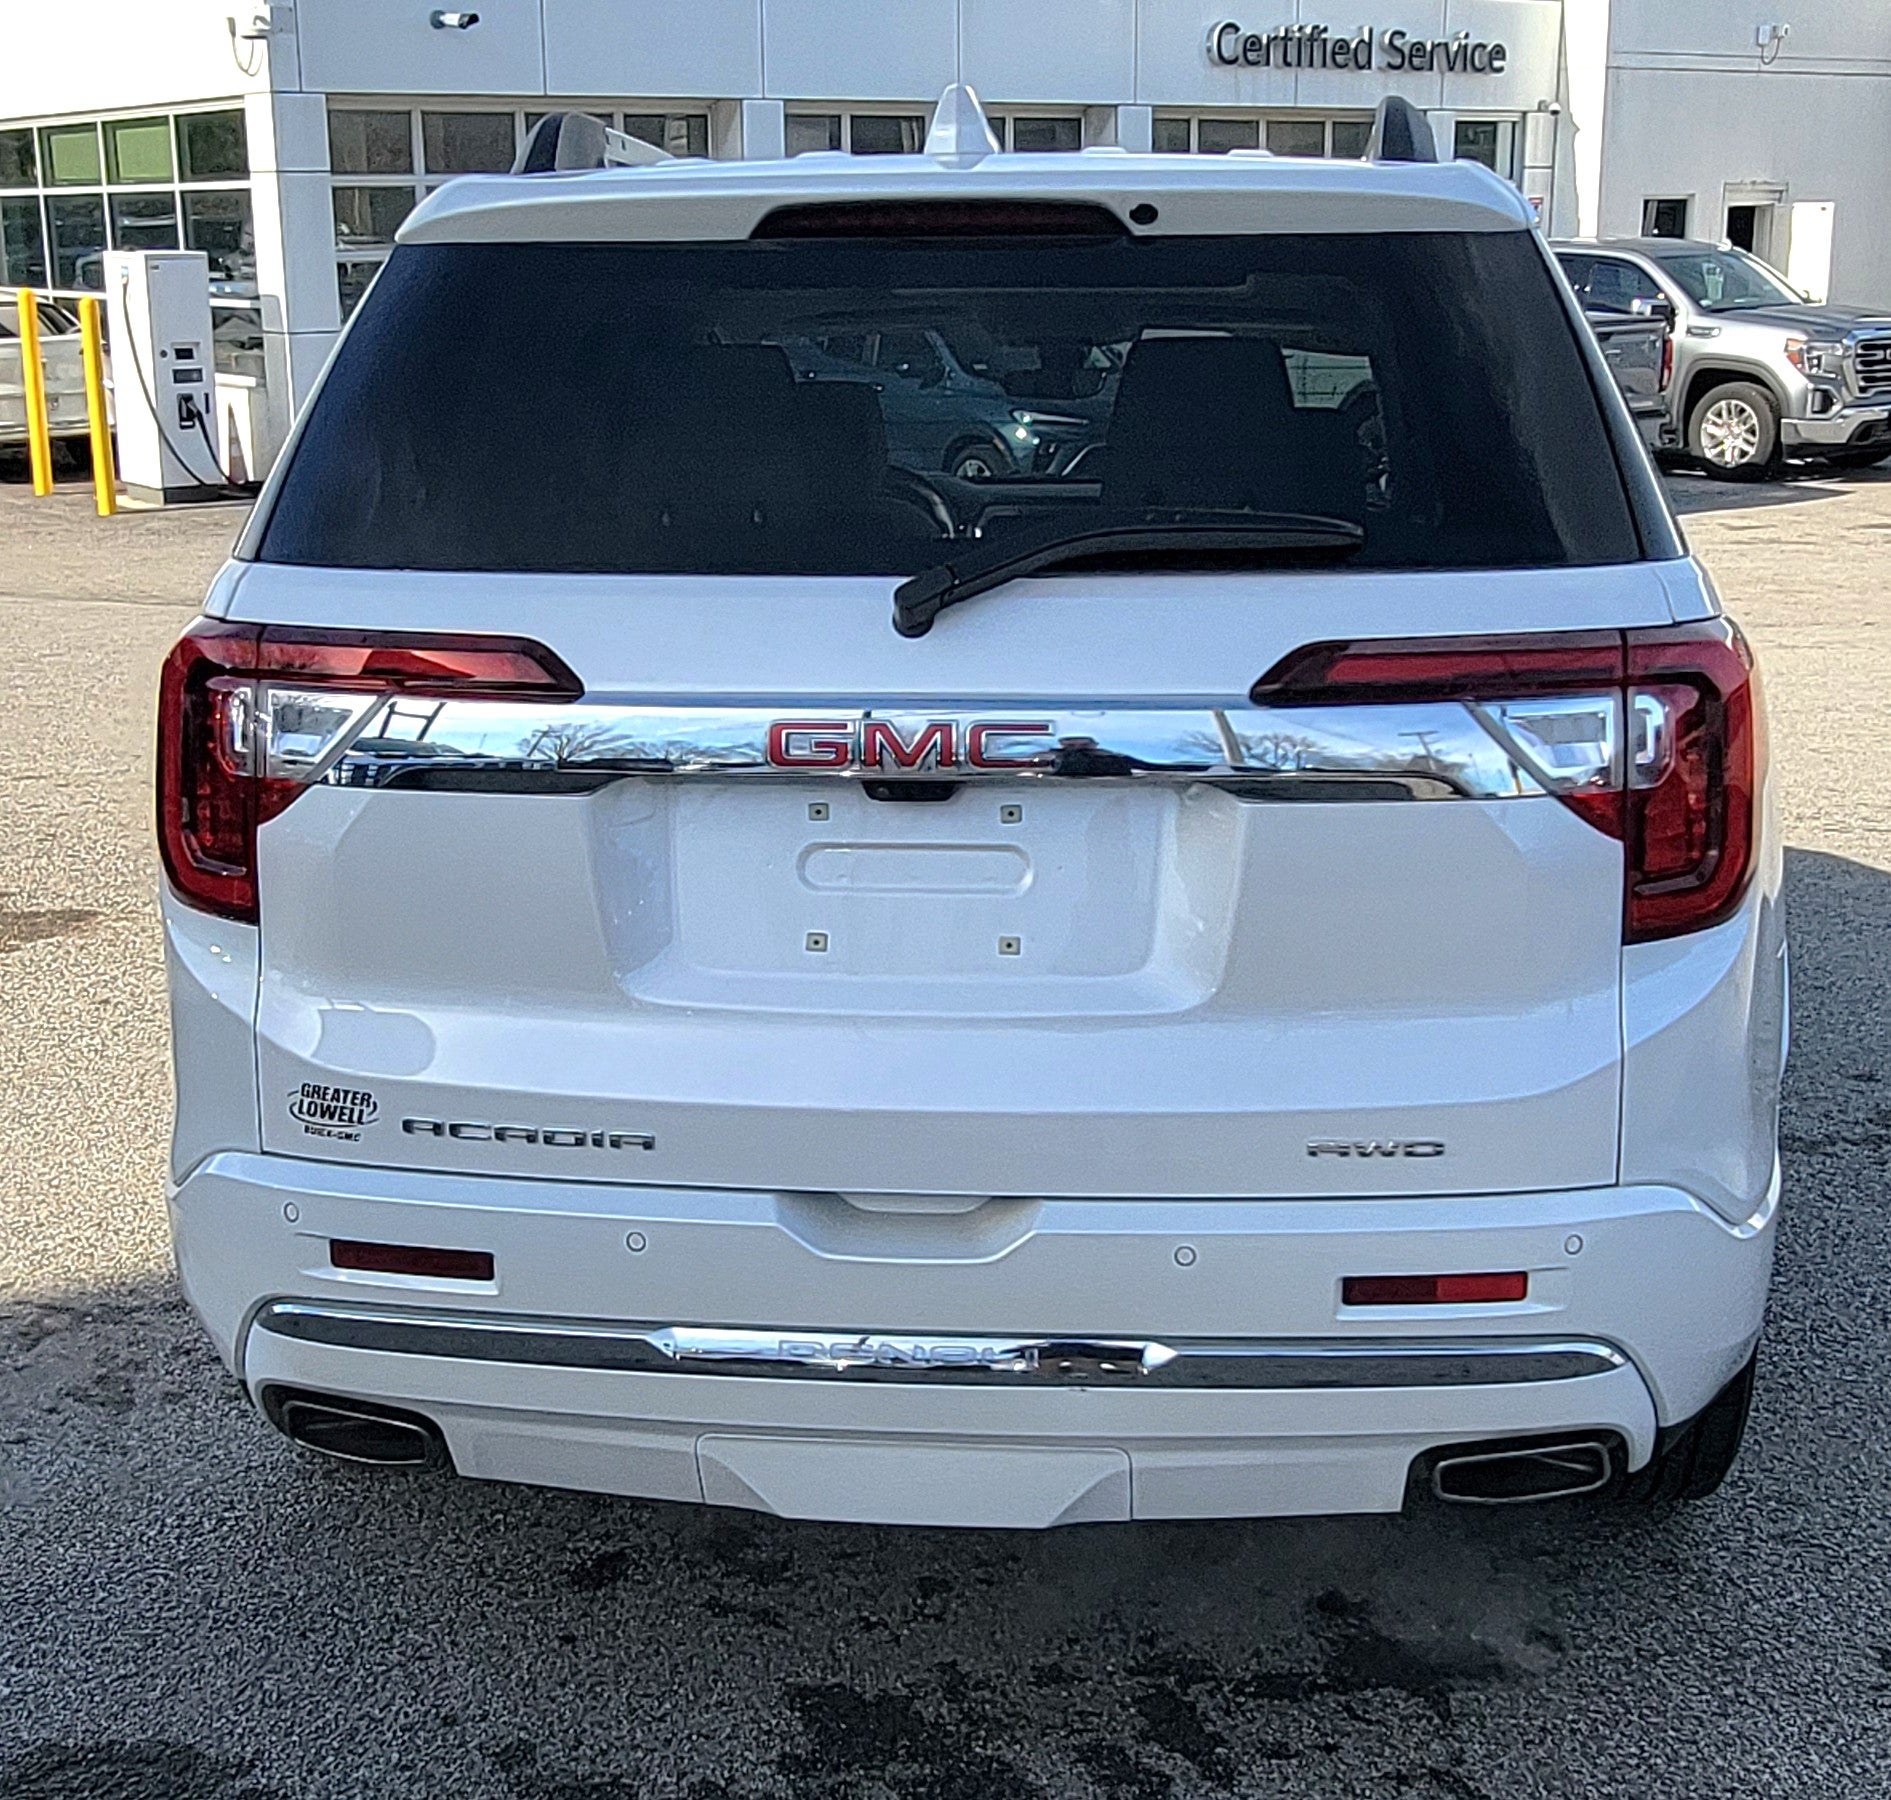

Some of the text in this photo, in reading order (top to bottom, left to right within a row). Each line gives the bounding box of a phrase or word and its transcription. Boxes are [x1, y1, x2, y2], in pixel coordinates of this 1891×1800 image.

[1209, 21, 1508, 74] Certified Service
[767, 718, 1056, 770] GMC
[301, 1082, 372, 1108] GREATER
[297, 1098, 365, 1126] LOWELL
[401, 1117, 656, 1151] ACADIA
[1306, 1140, 1445, 1158] AWD
